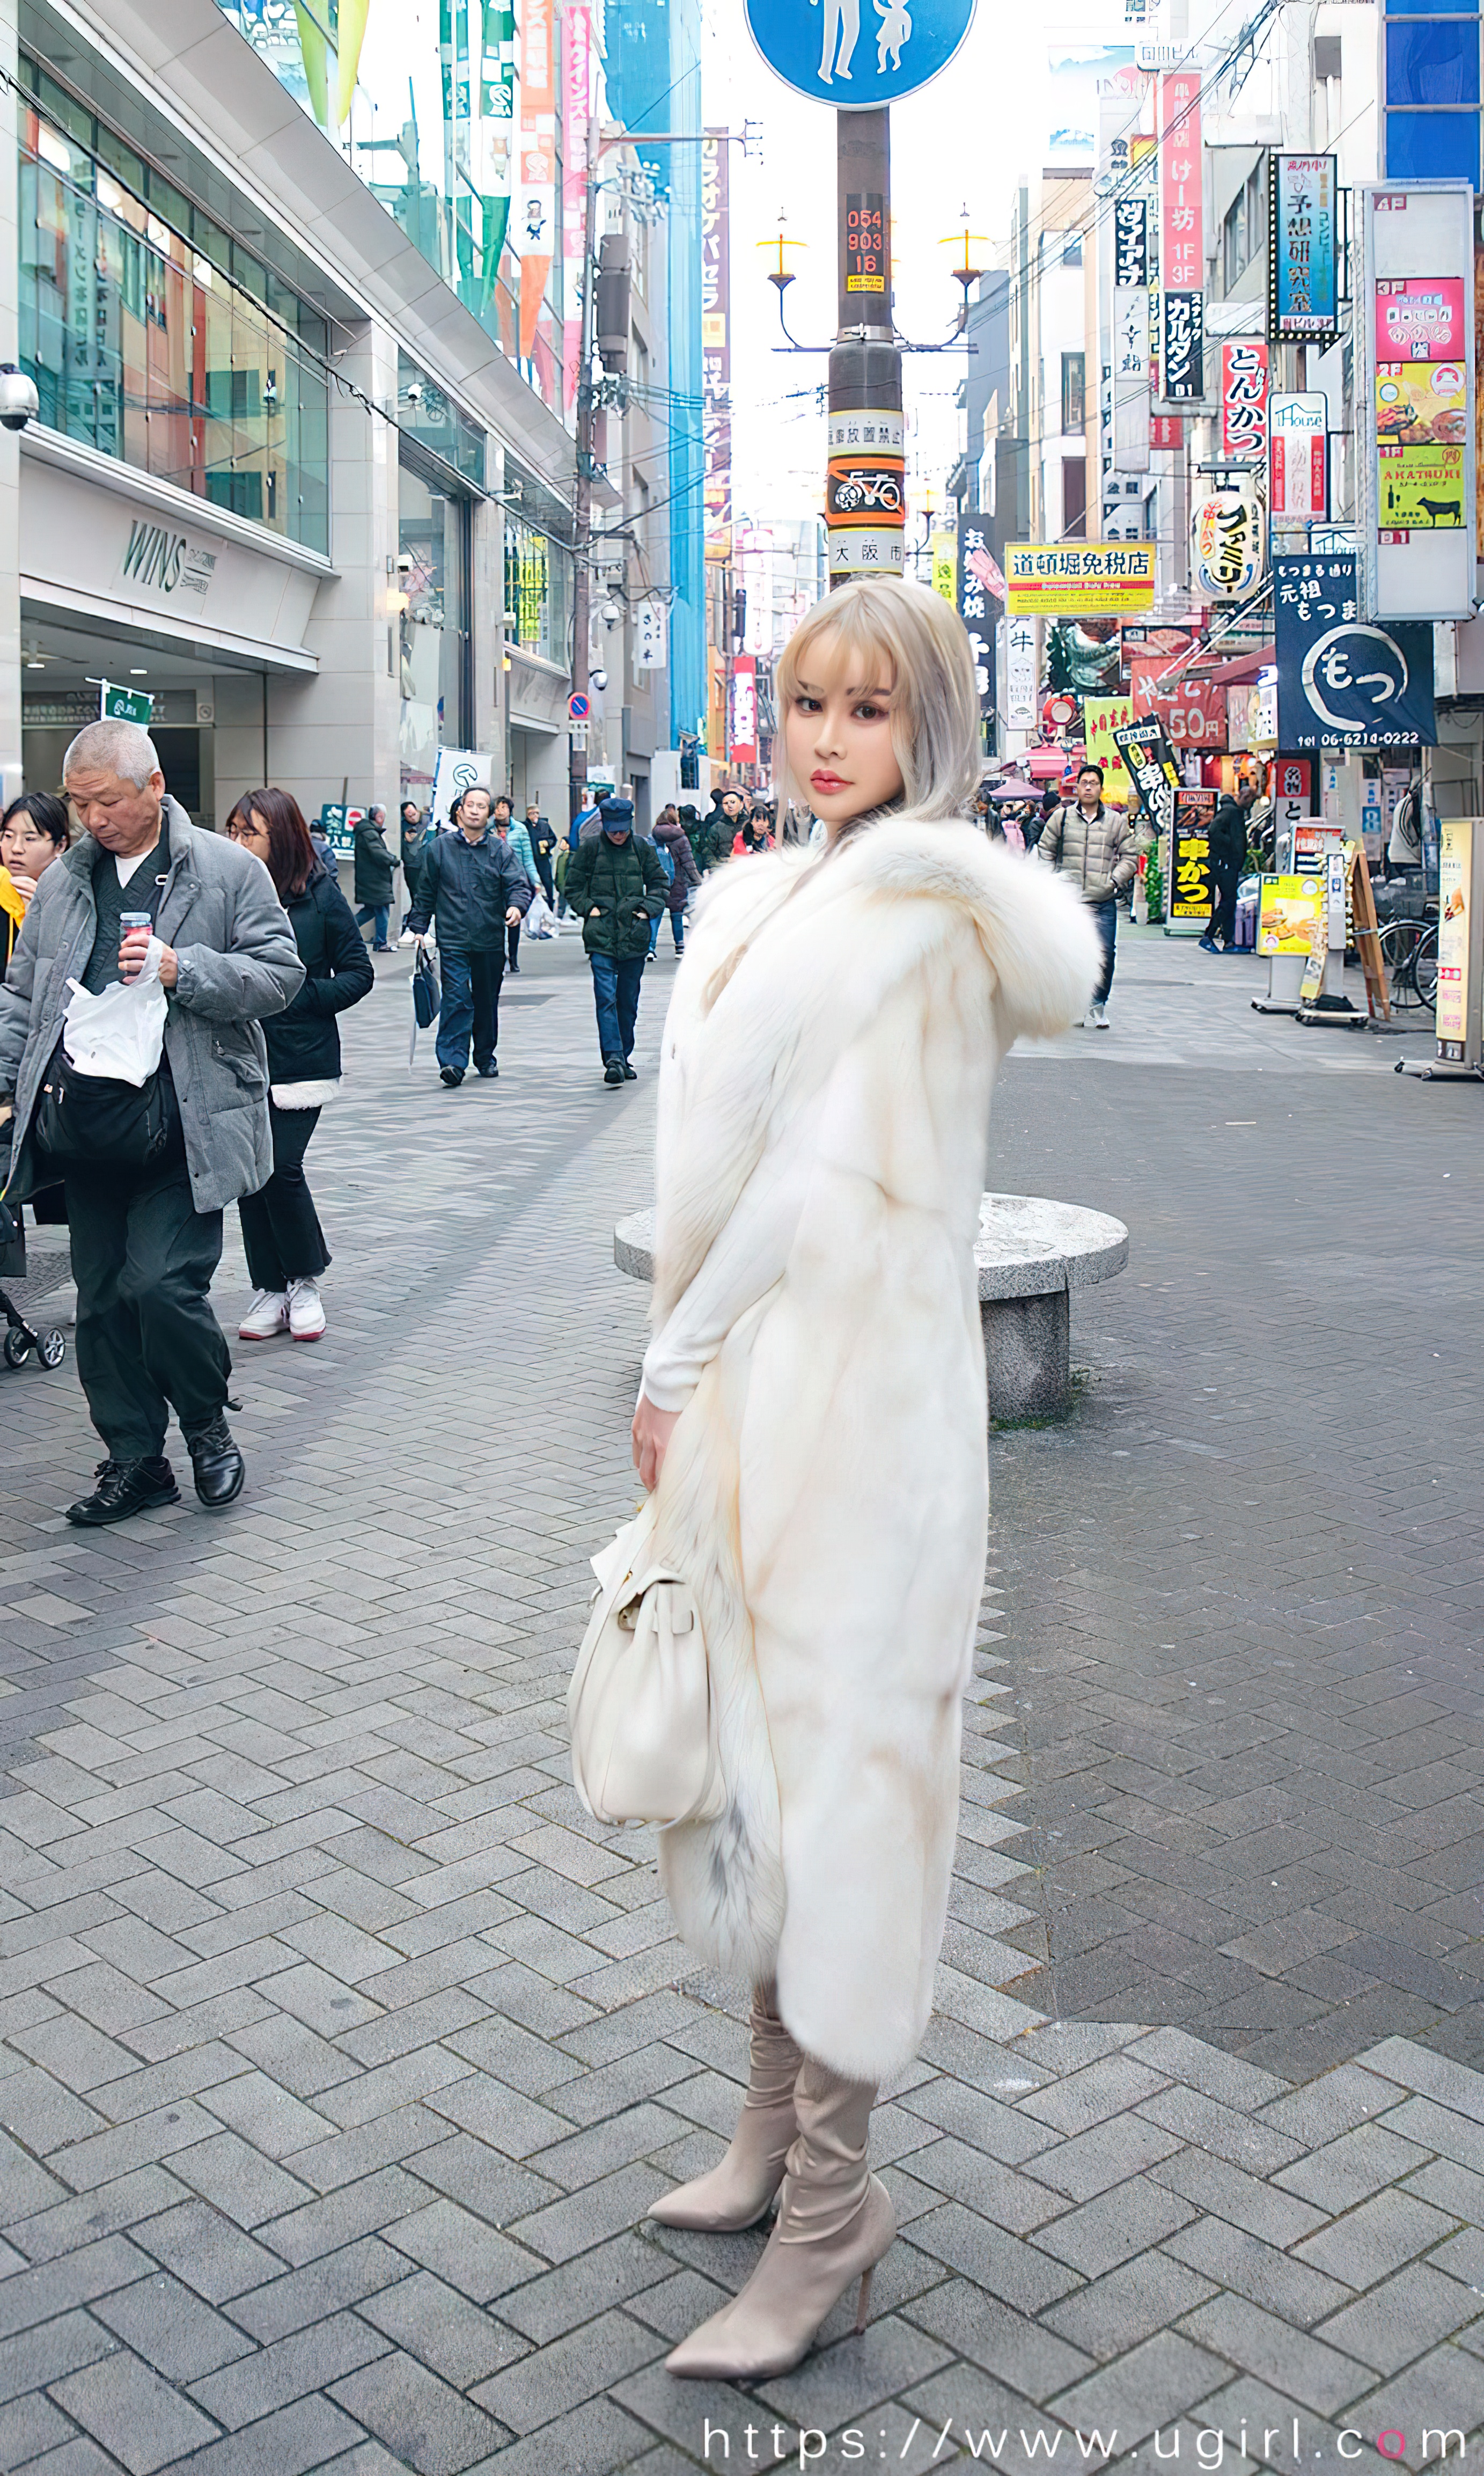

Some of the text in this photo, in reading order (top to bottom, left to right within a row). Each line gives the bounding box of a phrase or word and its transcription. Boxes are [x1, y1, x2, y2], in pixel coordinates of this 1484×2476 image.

[848, 233, 882, 251] 903
[856, 255, 876, 273] 16
[1167, 299, 1191, 383] カルダン
[1378, 363, 1402, 377] 2F
[1226, 345, 1266, 455] とんかつ
[123, 519, 186, 592] WINS
[836, 545, 901, 561] 大阪市
[1013, 552, 1149, 576] 道頓堀免税店
[1280, 580, 1322, 604] 元祖
[1320, 647, 1395, 704] もつ
